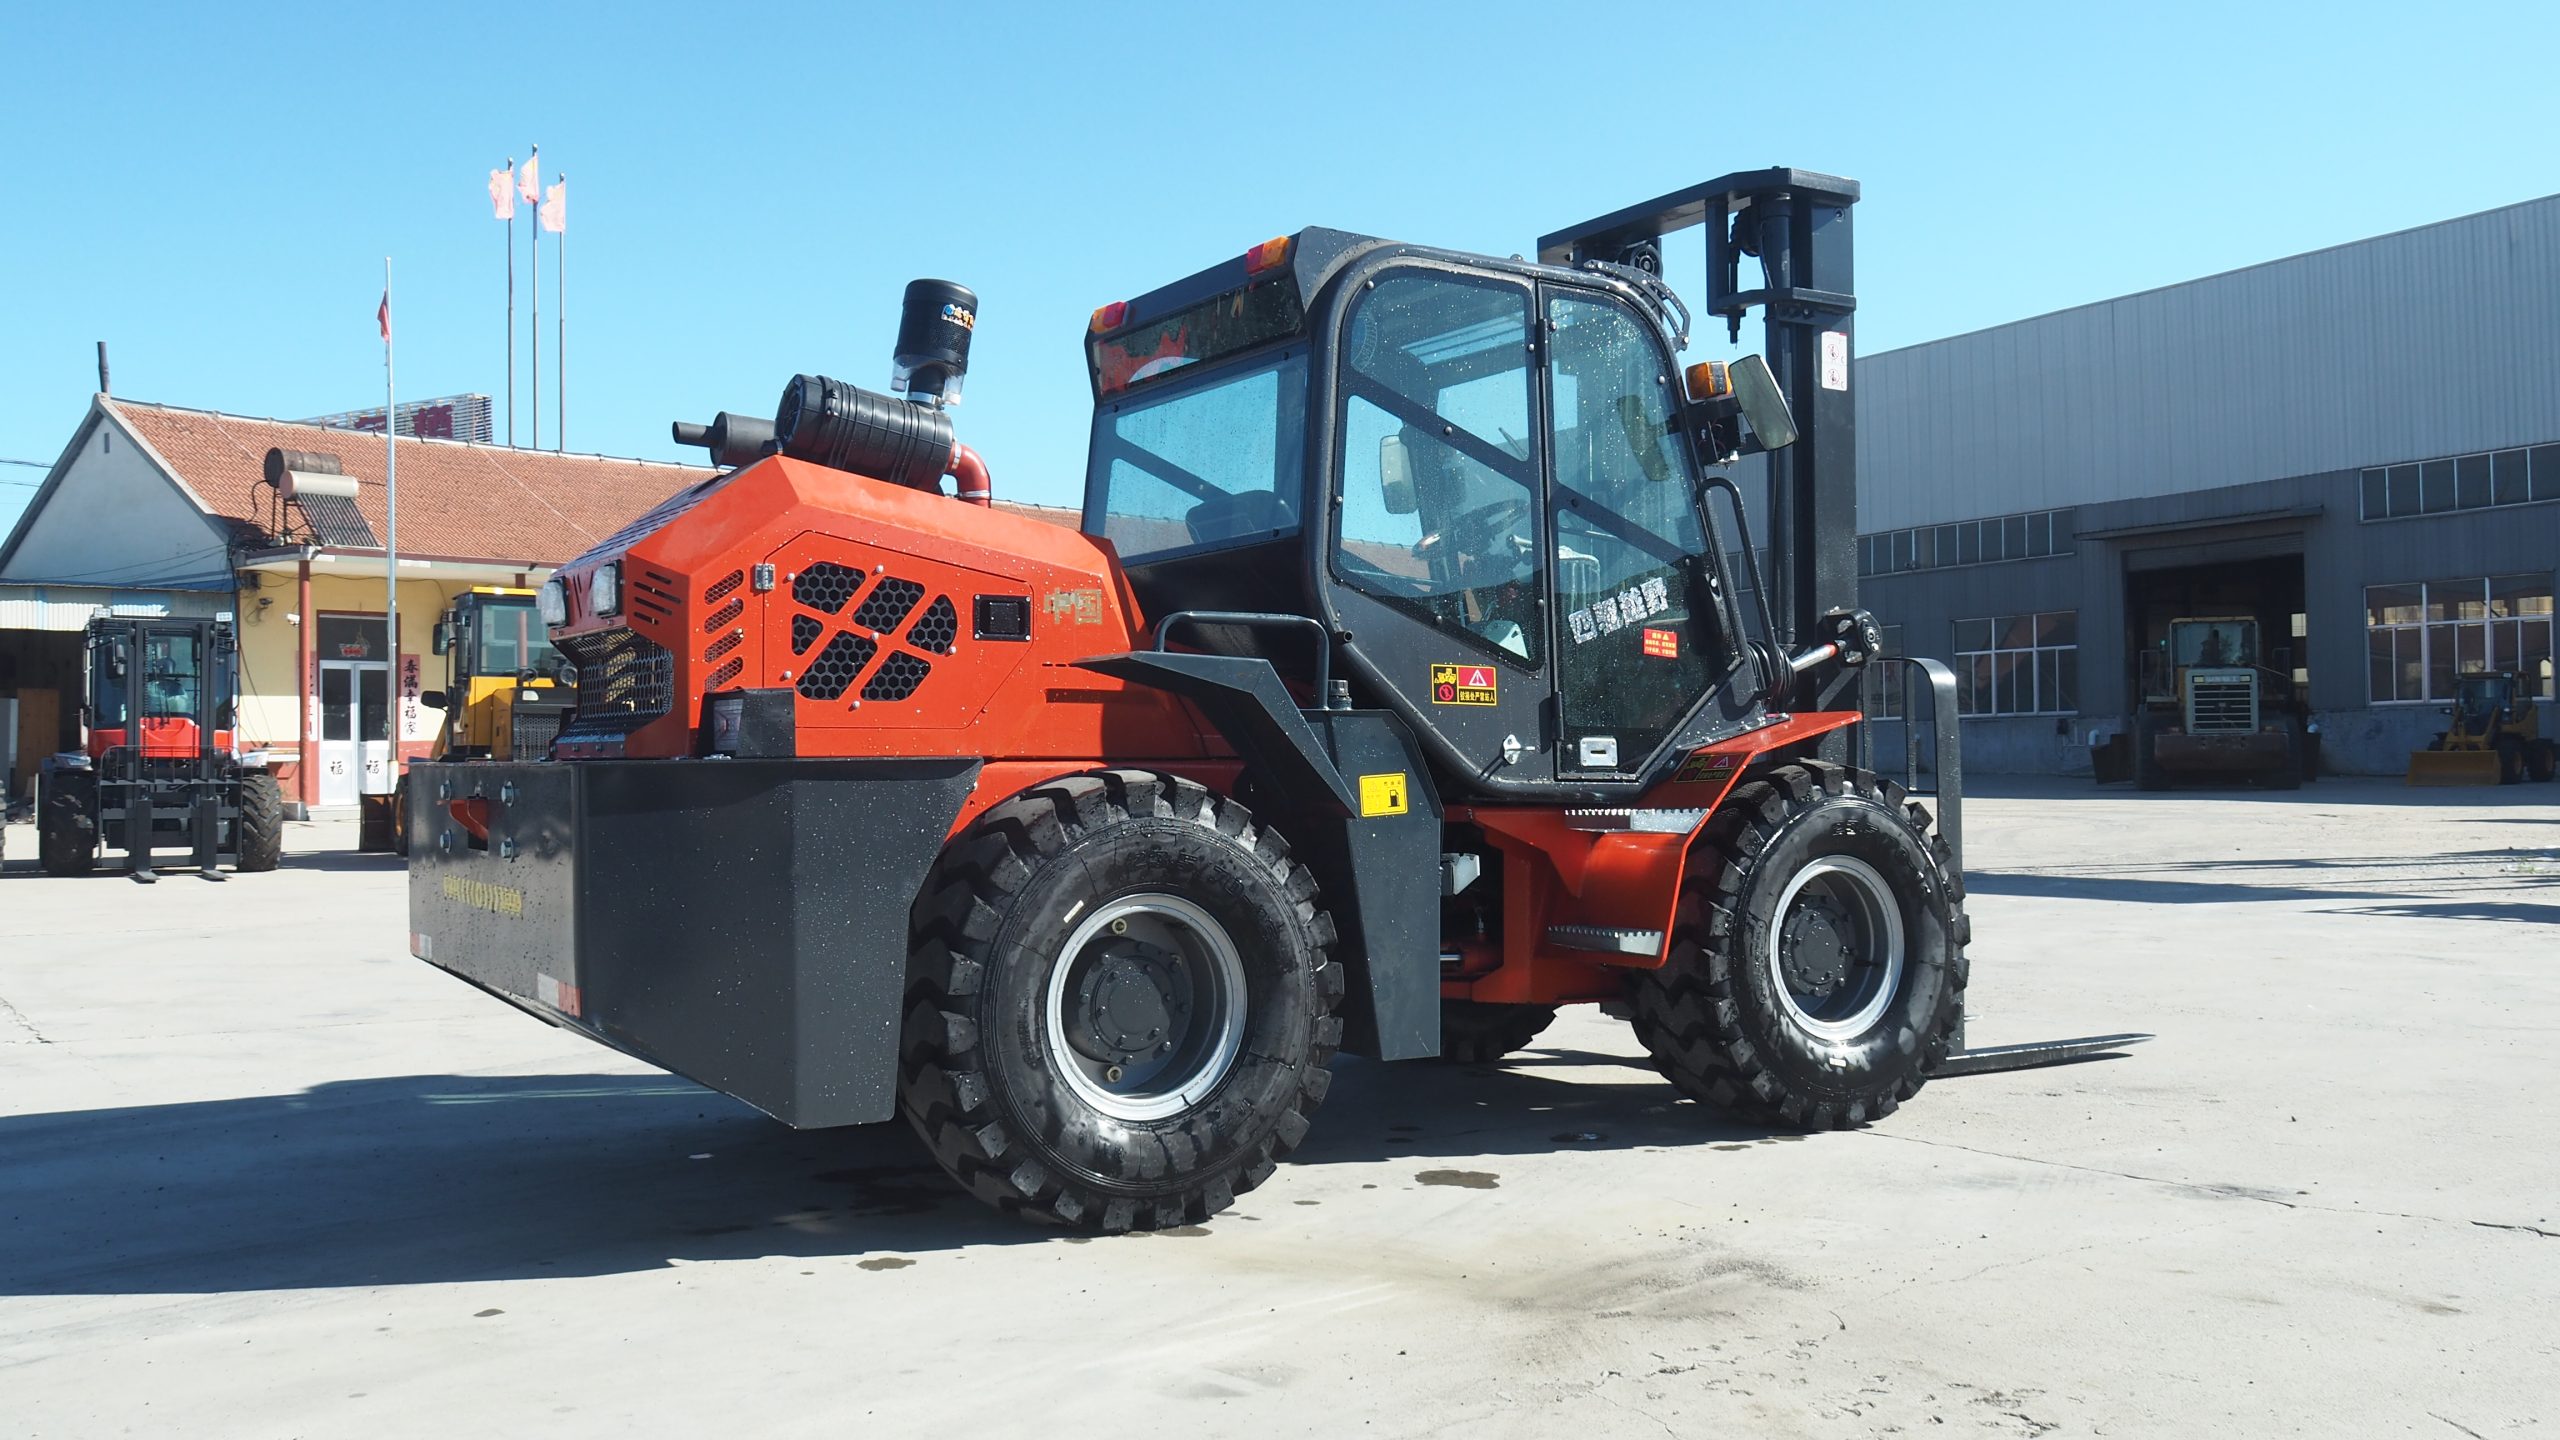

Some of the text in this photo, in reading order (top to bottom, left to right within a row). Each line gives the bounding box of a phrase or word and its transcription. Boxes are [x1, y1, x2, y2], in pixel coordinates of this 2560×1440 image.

[1568, 577, 1669, 644] 四驱越野
[330, 760, 343, 775] 福
[366, 760, 380, 774] 福
